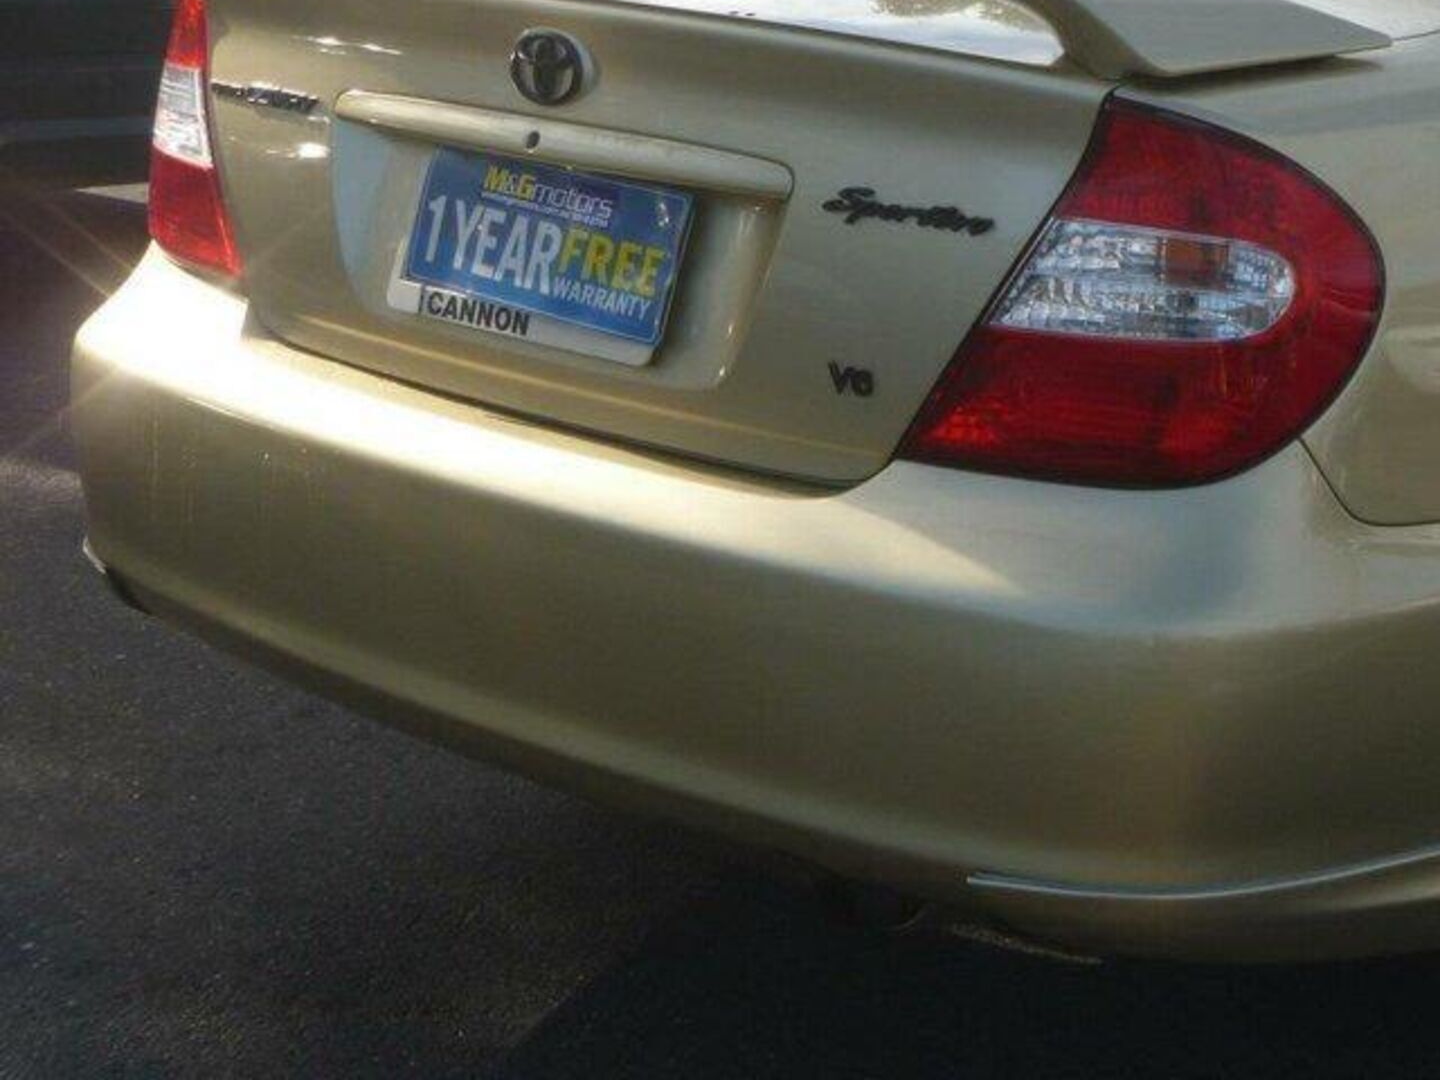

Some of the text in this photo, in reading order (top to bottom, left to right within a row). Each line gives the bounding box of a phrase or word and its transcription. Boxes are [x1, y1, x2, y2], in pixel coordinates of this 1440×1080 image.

[424, 195, 447, 263] 1
[452, 203, 562, 295] YEAR
[557, 226, 668, 296] FREE
[426, 290, 532, 336] CANNON
[552, 277, 652, 321] WARRANTY
[827, 359, 875, 397] V6
